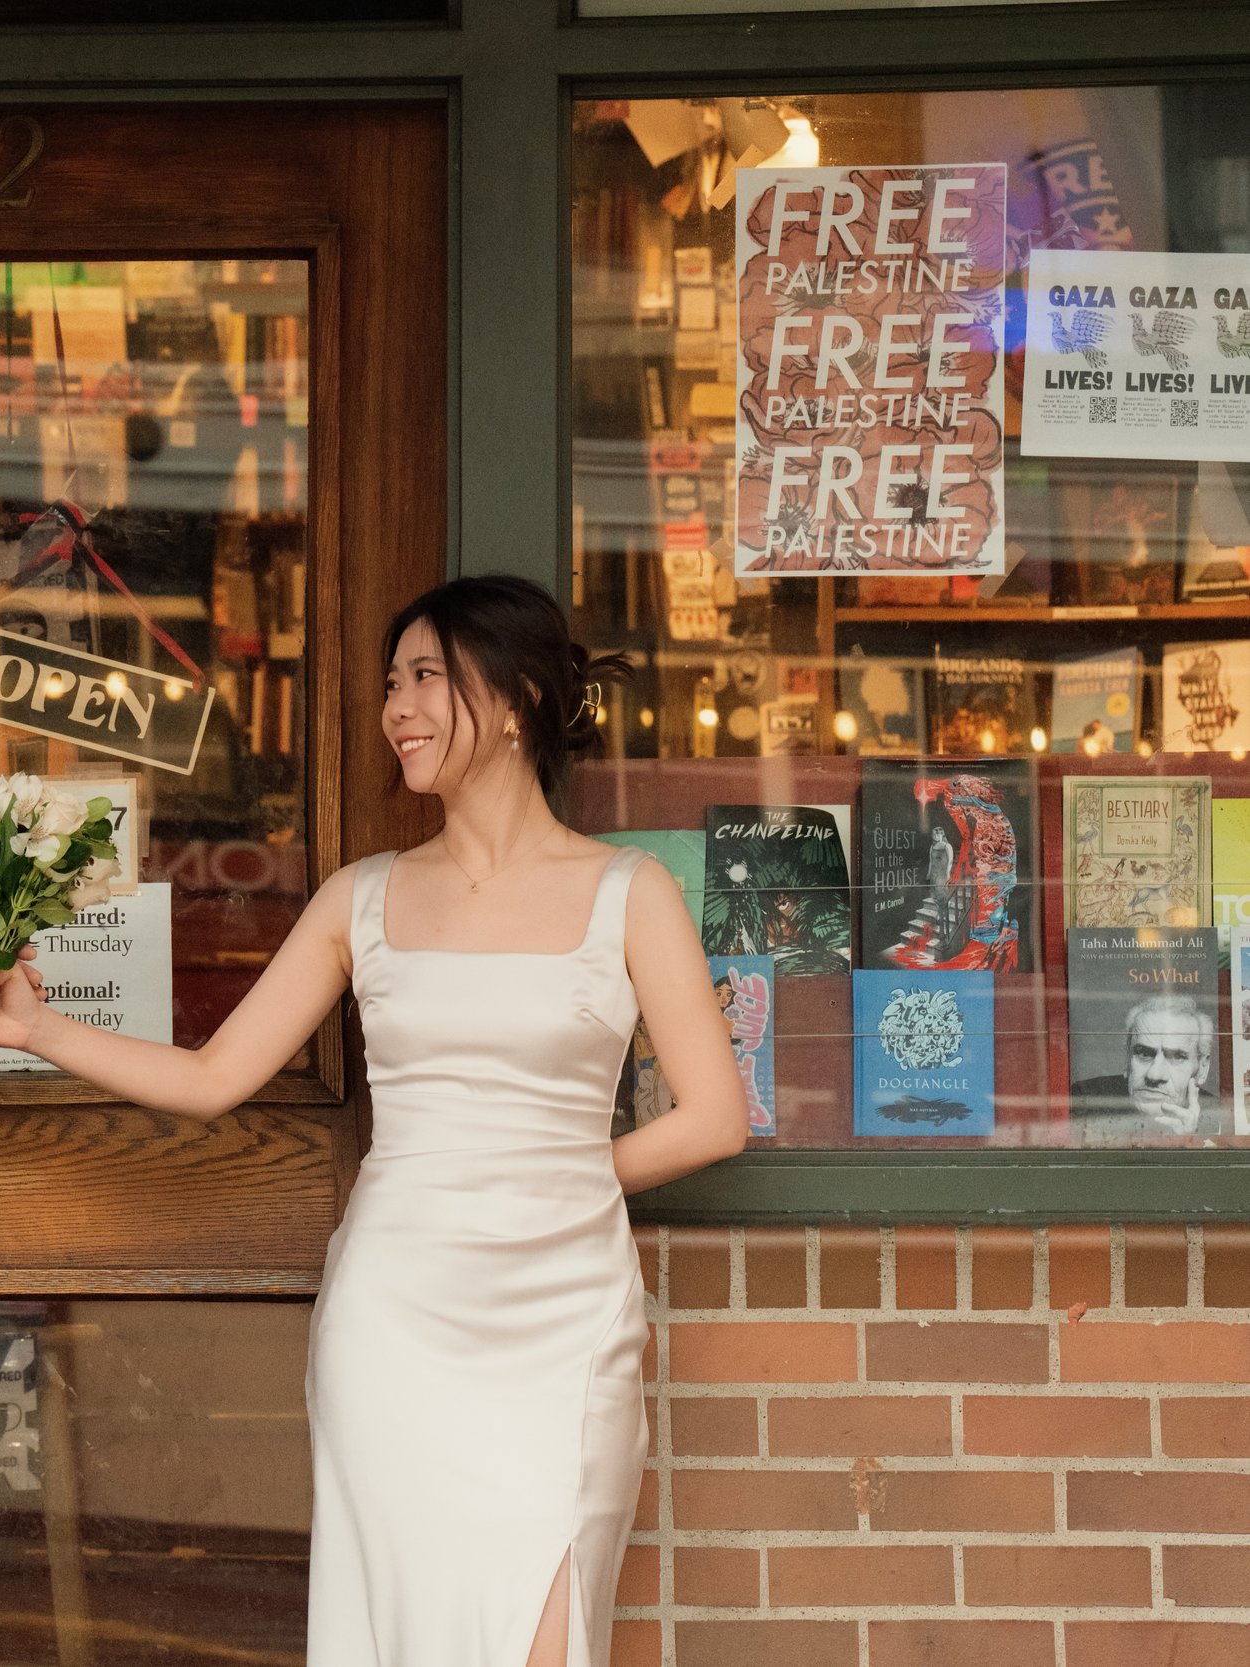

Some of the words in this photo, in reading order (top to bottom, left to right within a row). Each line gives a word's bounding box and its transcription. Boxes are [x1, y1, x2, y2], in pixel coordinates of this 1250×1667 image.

[767, 178, 975, 256] FREE
[765, 258, 973, 296] PALESTINE
[1049, 285, 1116, 309] GAZA
[1129, 286, 1198, 310] GAZA
[767, 313, 975, 390] FREE
[1045, 369, 1113, 391] LIVES!
[1126, 372, 1195, 393] LIVES!
[765, 392, 972, 429] PALESTINE
[767, 444, 975, 520] FREE
[764, 523, 972, 558] PALESTINE
[765, 811, 790, 823] THE
[874, 812, 881, 824] a
[1107, 800, 1169, 819] BESTIARY
[715, 822, 835, 841] CHANGELING
[874, 827, 917, 850] GUEST
[875, 853, 884, 868] in
[888, 852, 904, 867] the
[874, 867, 919, 895] HOUSE
[874, 901, 886, 913] E.M.
[45, 934, 133, 957] Thursday
[1080, 938, 1108, 949] Taha
[1111, 937, 1183, 949] Muhammad
[1186, 937, 1204, 948] Ali
[1128, 969, 1150, 984] So
[1152, 968, 1200, 984] What
[878, 1078, 970, 1090] DOGTANGLE
